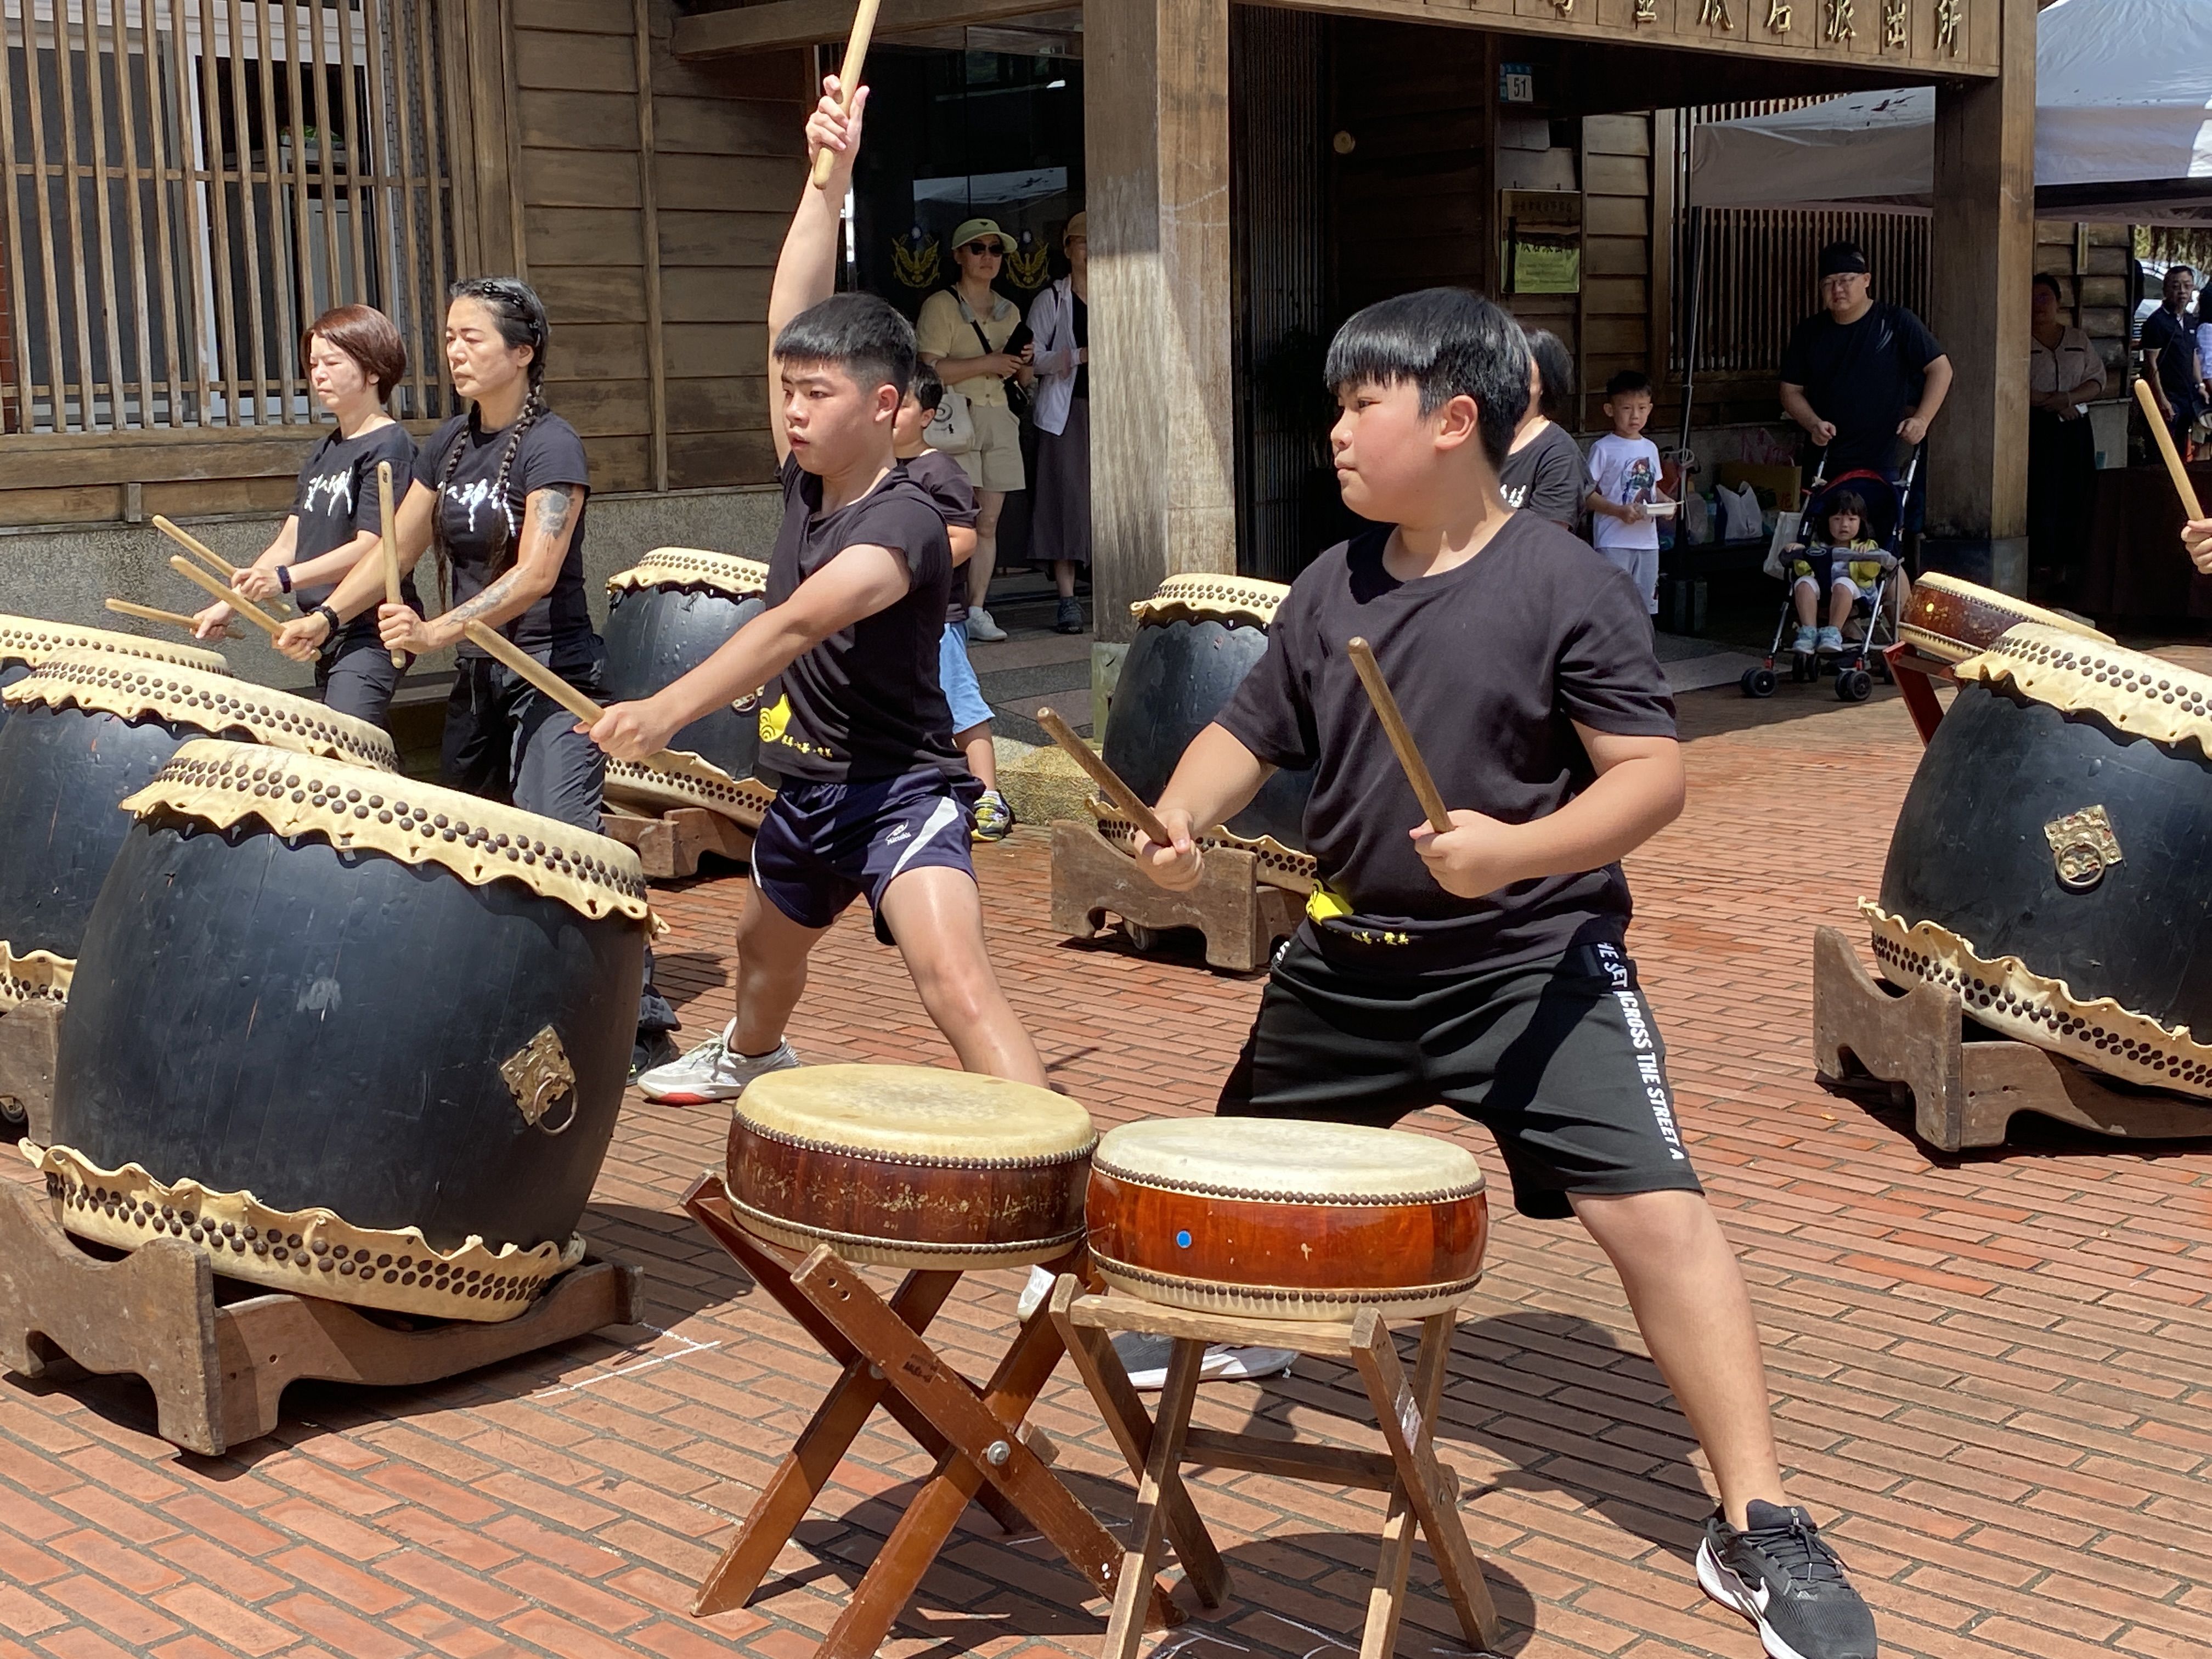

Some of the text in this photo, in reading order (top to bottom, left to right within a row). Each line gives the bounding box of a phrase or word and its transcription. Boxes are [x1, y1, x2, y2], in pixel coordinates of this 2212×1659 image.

[1514, 78, 1526, 98] 51
[1637, 1052, 1661, 1084] THE
[1646, 1087, 1679, 1147] STREET
